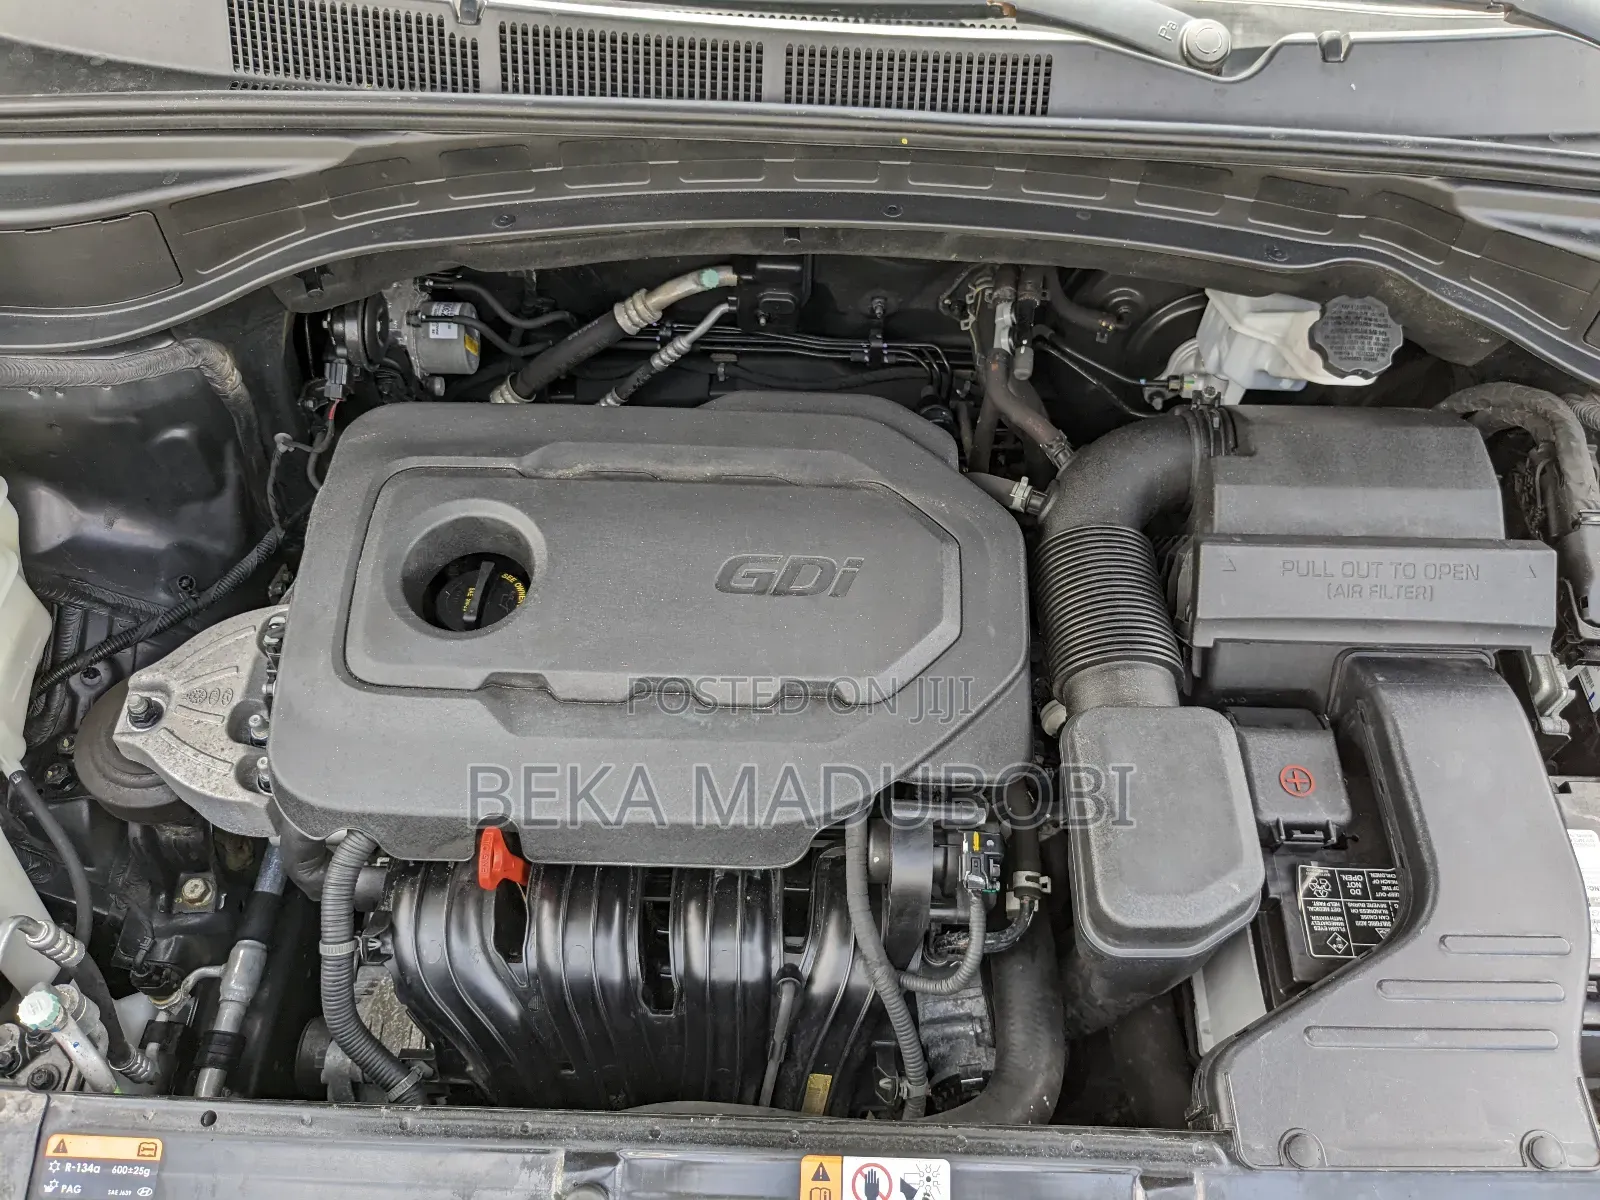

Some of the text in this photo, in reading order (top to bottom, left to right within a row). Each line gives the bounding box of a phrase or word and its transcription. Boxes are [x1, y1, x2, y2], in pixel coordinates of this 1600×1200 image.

[501, 573, 517, 583] SEE
[714, 553, 865, 598] GDi
[1280, 559, 1480, 581] PULL OUT TO OPEN
[1326, 582, 1434, 602] (AIR FILTER)
[64, 1161, 151, 1178] R-134a 600±25g
[60, 1184, 82, 1194] PAG
